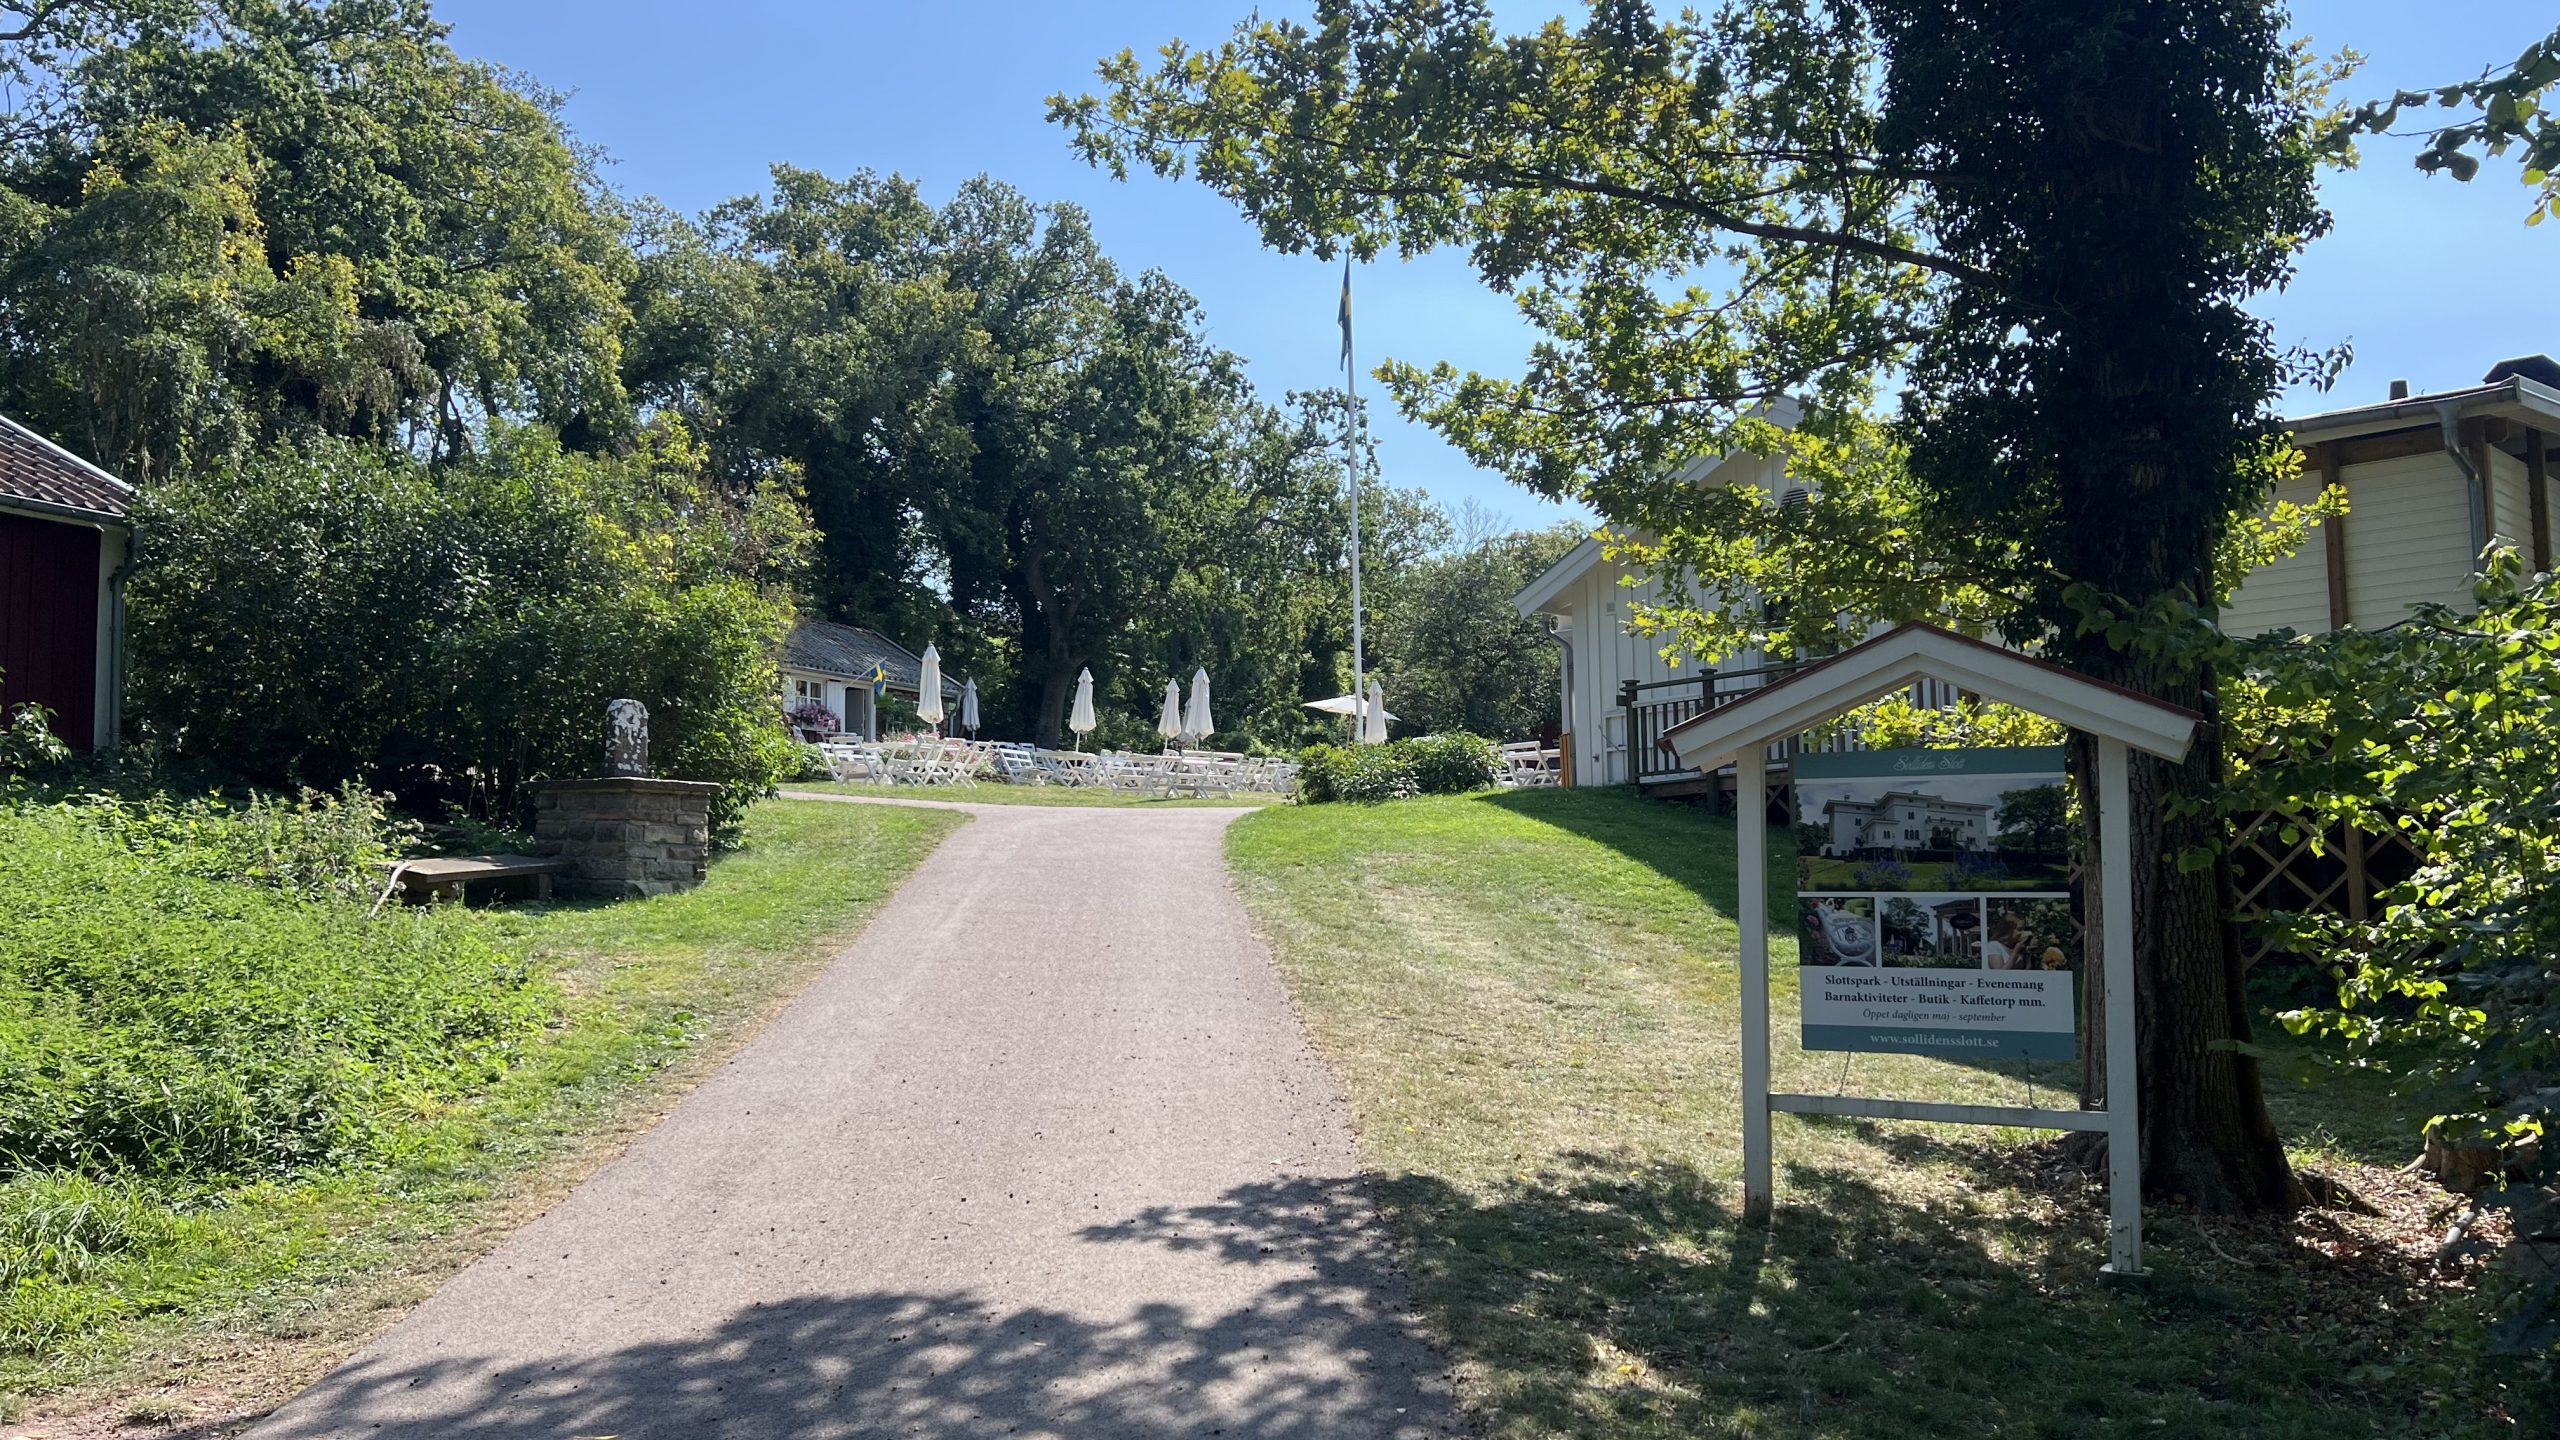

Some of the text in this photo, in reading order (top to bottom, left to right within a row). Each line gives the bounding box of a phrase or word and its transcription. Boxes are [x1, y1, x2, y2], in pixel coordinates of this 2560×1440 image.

[1825, 974, 1881, 988] Slottspark
[1891, 975, 1966, 990] Utställningar
[1977, 978, 2044, 992] Evenemang
[1825, 991, 1908, 1003] Barnaktiviteter
[1918, 993, 1950, 1004] Butik
[1960, 994, 2016, 1008] Kaffetorp
[2019, 998, 2046, 1007] mm.
[1863, 1008, 1890, 1021] Öppet
[1892, 1009, 1930, 1022] dagligen
[1932, 1011, 1950, 1023] maj
[1958, 1012, 2006, 1024] september
[1870, 1032, 1999, 1047] www.sollidensslott.se
